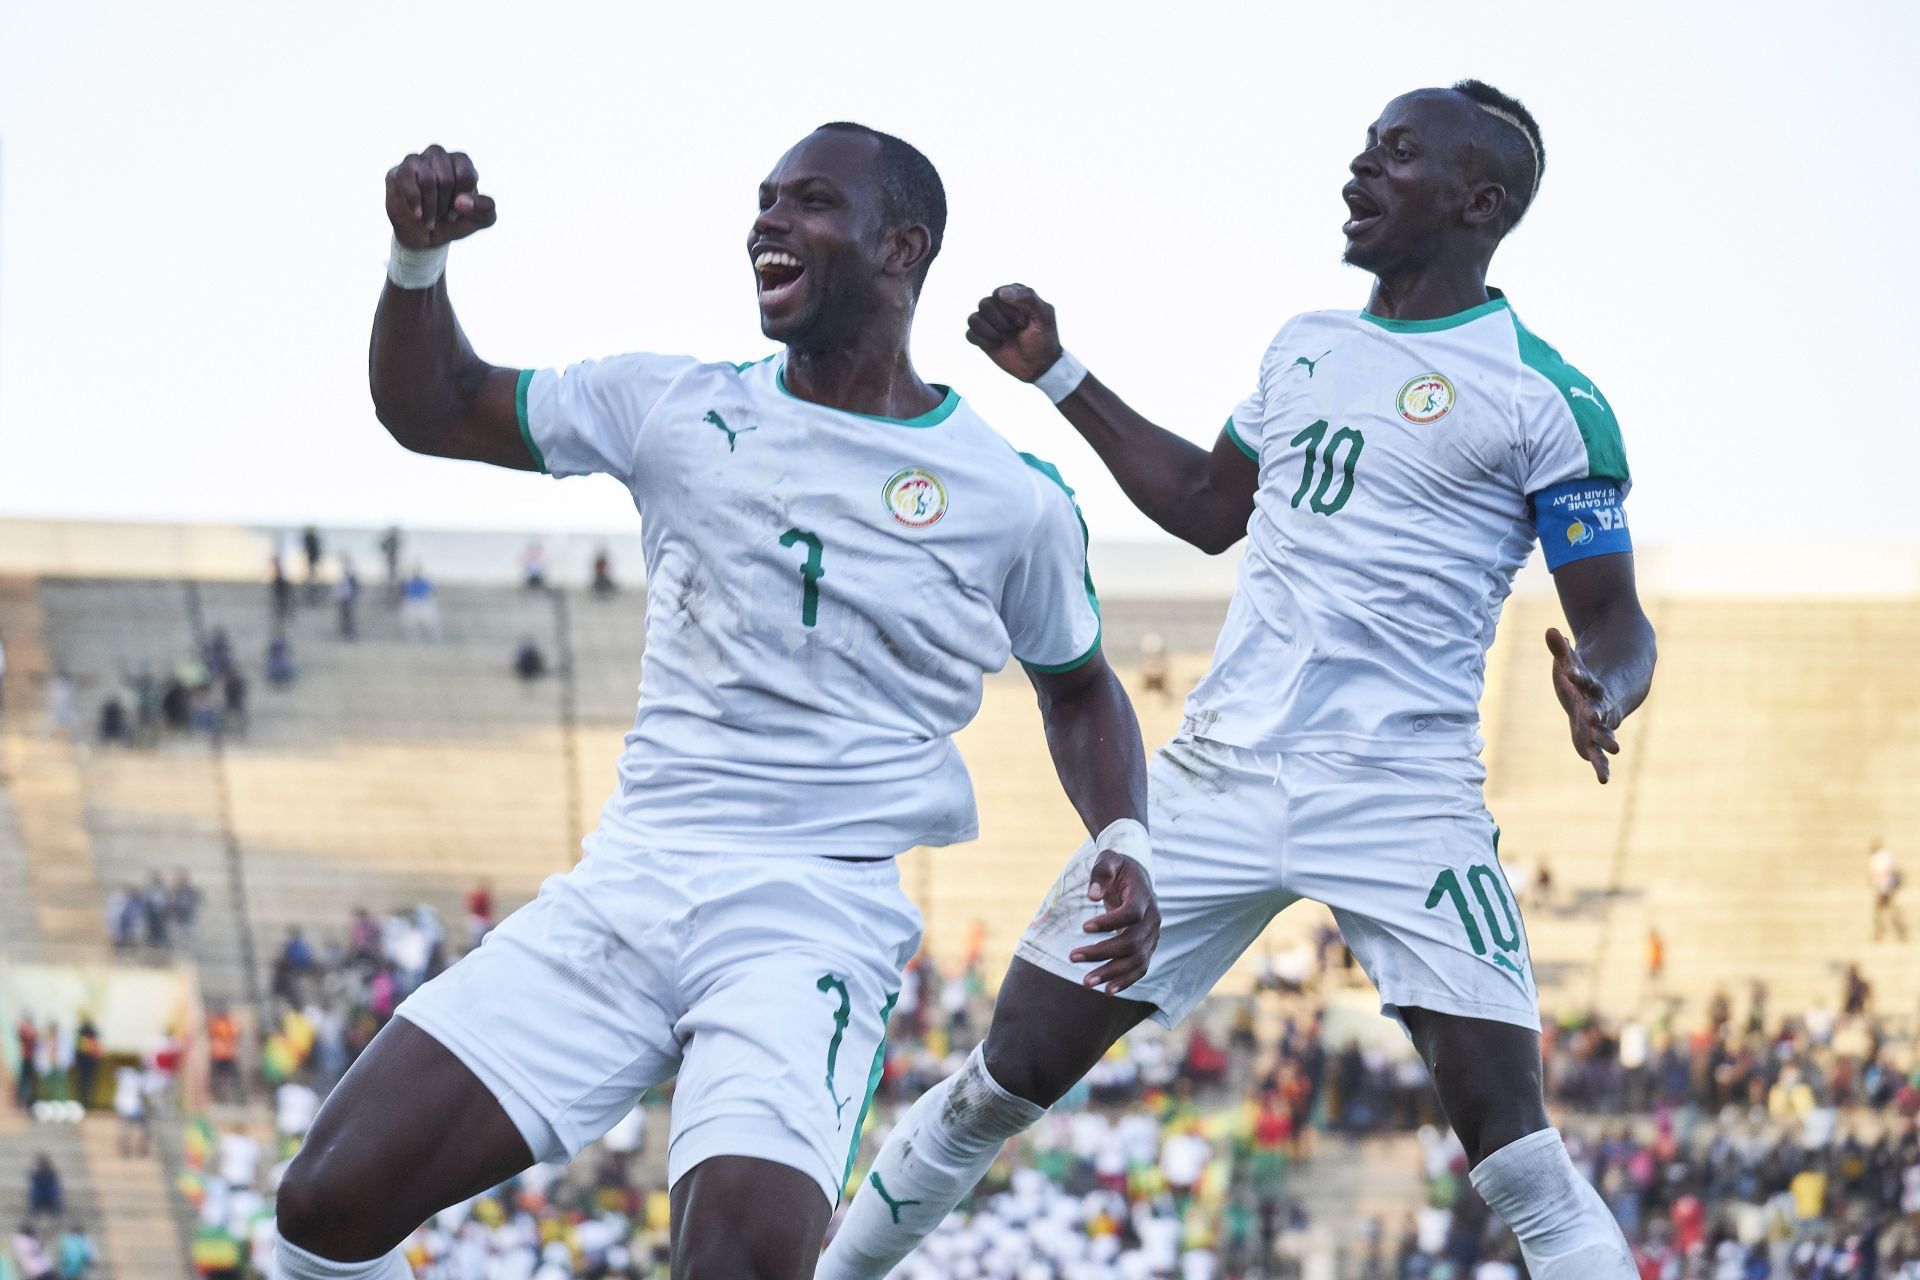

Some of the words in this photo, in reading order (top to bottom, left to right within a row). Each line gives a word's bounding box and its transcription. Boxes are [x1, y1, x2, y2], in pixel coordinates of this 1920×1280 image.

[1291, 419, 1364, 517] 10
[1584, 489, 1606, 500] FAIR
[1608, 488, 1614, 497] IS
[1553, 493, 1581, 506] PLAY
[1568, 499, 1601, 511] GAME
[1603, 497, 1615, 506] MY
[779, 528, 824, 628] 7
[1425, 864, 1520, 956] 10
[816, 973, 851, 1078] 7
